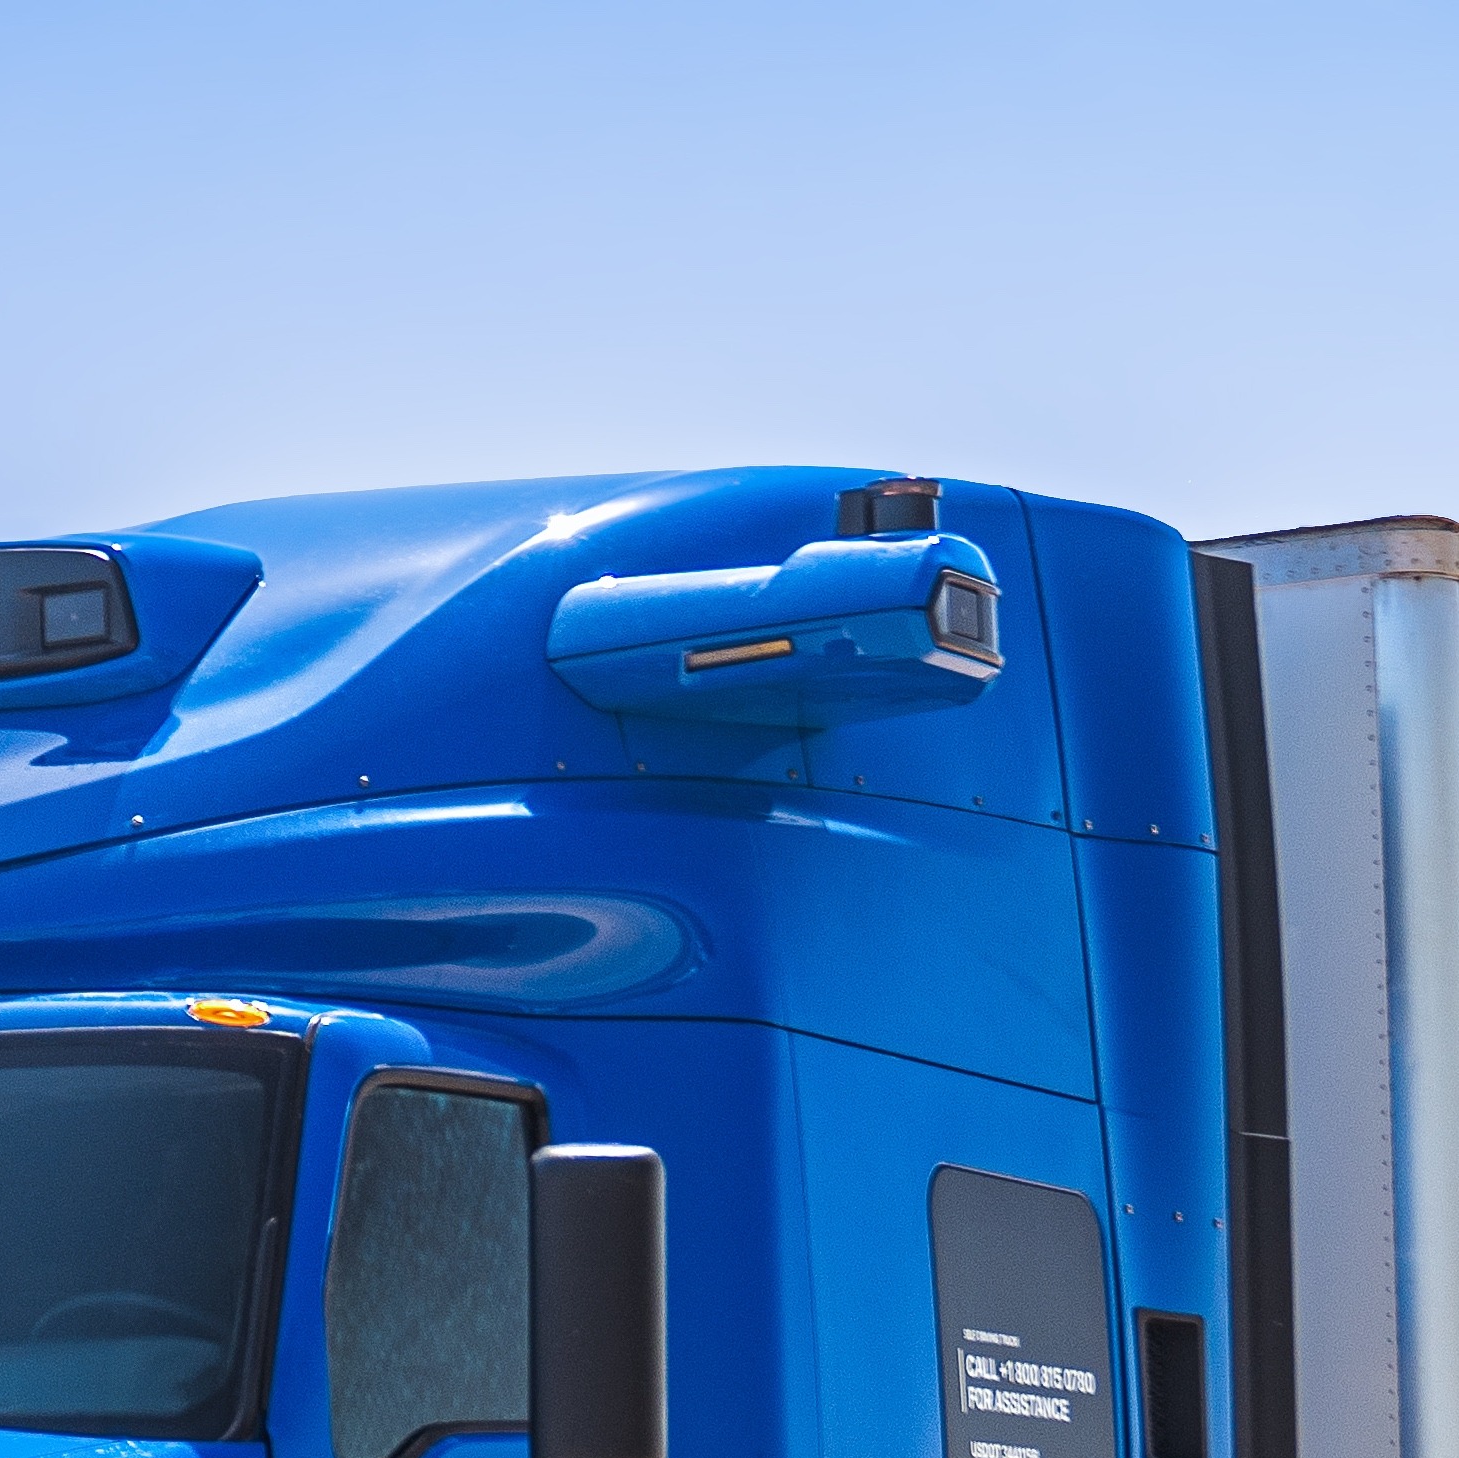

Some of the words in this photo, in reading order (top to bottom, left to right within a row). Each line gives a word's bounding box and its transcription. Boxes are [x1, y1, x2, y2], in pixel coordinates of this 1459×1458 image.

[966, 1354, 1000, 1382] CALL
[1000, 1360, 1015, 1383] +1
[1015, 1361, 1040, 1388] 800
[1041, 1365, 1063, 1390] 815
[967, 1386, 994, 1412] FOR
[995, 1389, 1071, 1423] ASSISTANCE
